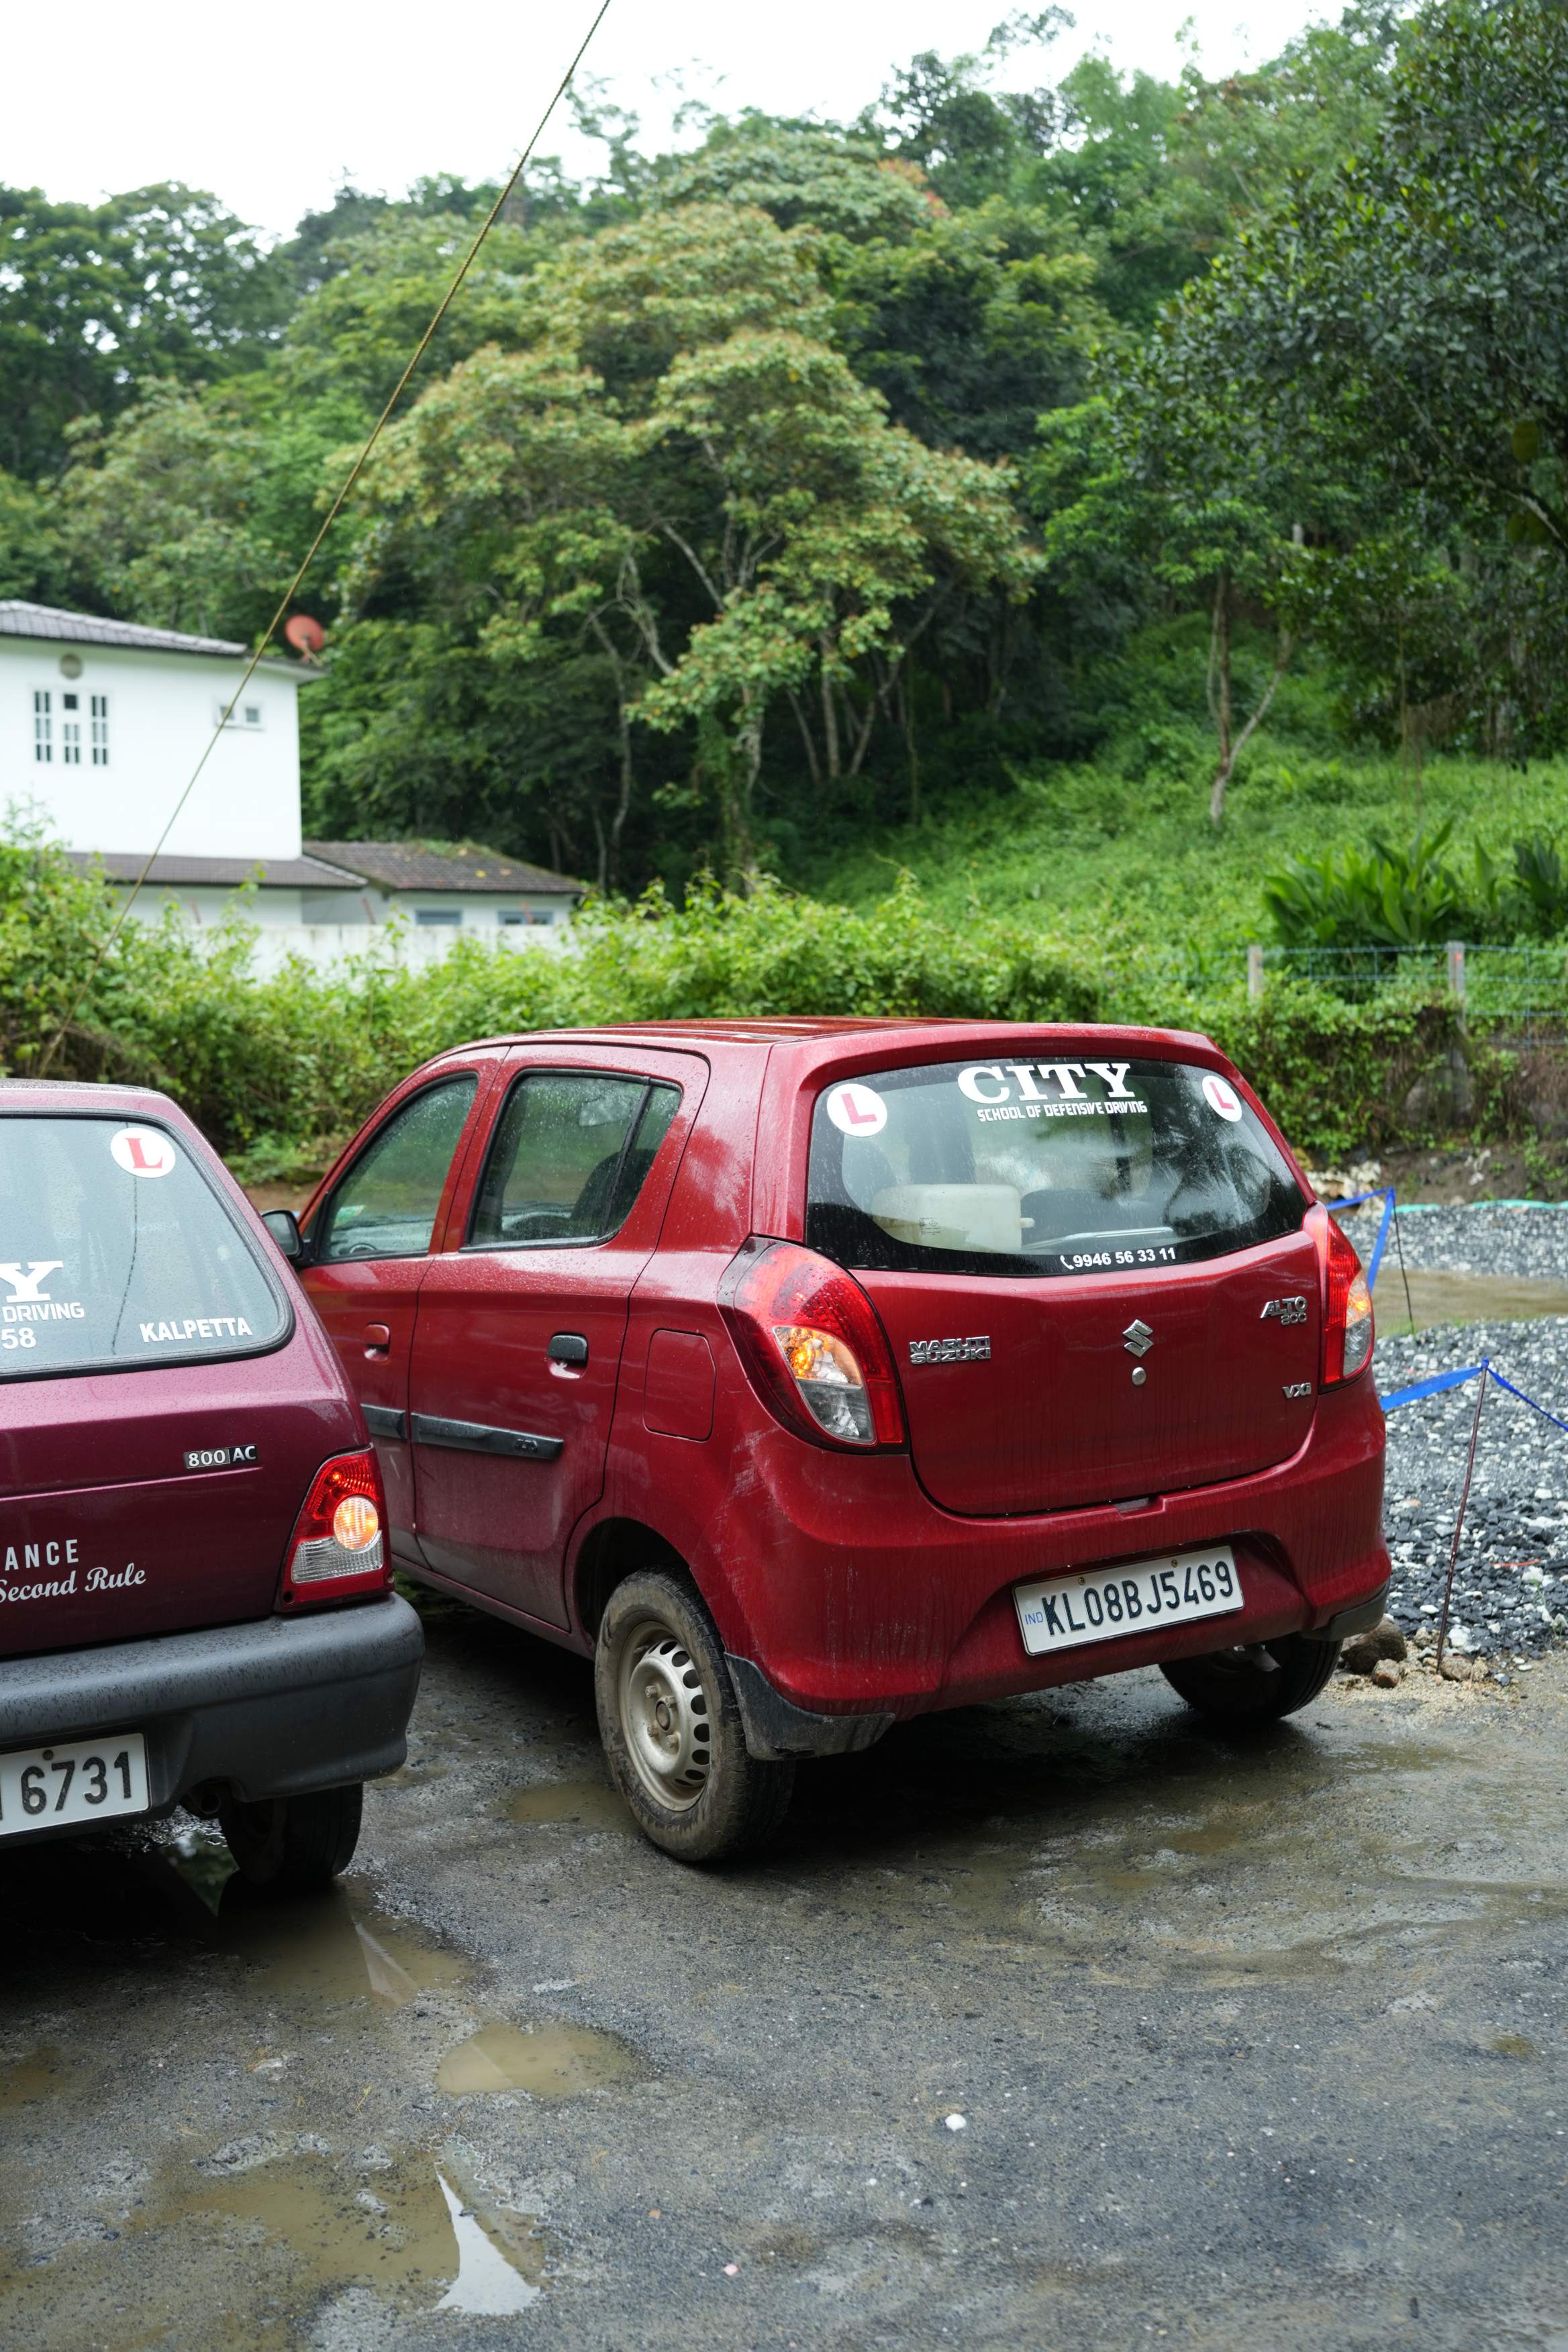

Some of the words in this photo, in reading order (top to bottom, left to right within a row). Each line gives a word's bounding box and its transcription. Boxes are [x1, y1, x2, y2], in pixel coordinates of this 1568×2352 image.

[957, 1063, 1136, 1104] CITY
[1209, 1081, 1235, 1110] L
[841, 1093, 877, 1124] L
[977, 1106, 1026, 1122] SCHOOL
[1028, 1104, 1042, 1118] OF
[1042, 1101, 1104, 1117] DEFENSIVE
[1106, 1100, 1148, 1114] DRIVING
[124, 1137, 163, 1169] L
[1073, 1253, 1112, 1268] 9946
[1114, 1251, 1134, 1264] 56
[1137, 1248, 1156, 1263] 33
[1159, 1246, 1176, 1261] 11
[3, 1302, 85, 1323] DRIVING
[1259, 1295, 1308, 1319] ALTO
[1281, 1311, 1307, 1326] 800
[0, 1327, 36, 1350] 58
[139, 1317, 252, 1342] KALPETTA
[910, 1335, 990, 1353] MARUTI
[910, 1347, 991, 1365] SUZUKI
[188, 1449, 226, 1467] 800
[232, 1445, 256, 1462] AC
[4, 1538, 79, 1571] ANCE
[84, 1562, 146, 1592] Rule
[1041, 1560, 1234, 1636] KL08BJ5469
[1024, 1611, 1044, 1626] IND
[20, 1751, 132, 1815] 6731
